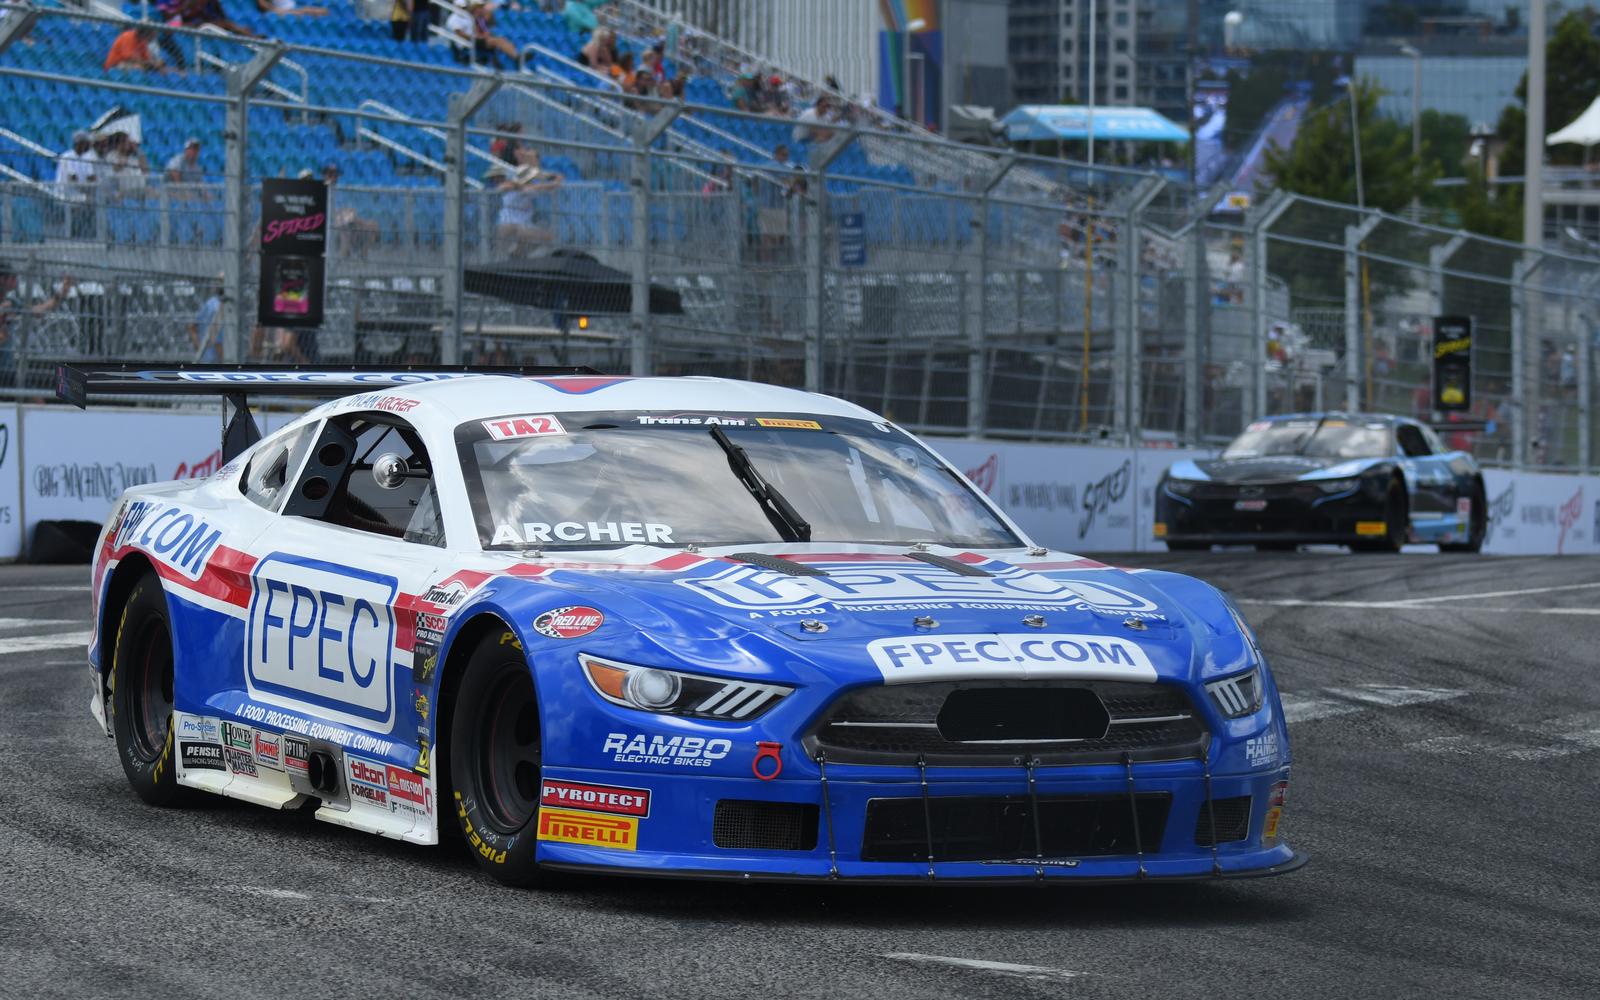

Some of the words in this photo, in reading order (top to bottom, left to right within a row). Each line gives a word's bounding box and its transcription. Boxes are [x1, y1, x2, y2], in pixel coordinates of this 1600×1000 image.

[491, 417, 558, 437] TA2
[637, 416, 702, 425] Trans
[704, 416, 746, 426] Am
[490, 521, 676, 546] ARCHER
[422, 584, 449, 605] Trans
[447, 589, 466, 606] Am
[552, 615, 577, 626] RED
[574, 615, 601, 626] LINE
[749, 612, 764, 621] A
[772, 607, 827, 619] FOOD
[832, 602, 953, 613] PROCESSING
[960, 602, 1068, 612] EQUIPMENT
[261, 578, 379, 689] FPEC
[416, 629, 428, 640] PRO
[425, 615, 447, 632] SCCA
[882, 640, 1138, 668] FPEC.COM
[234, 703, 245, 717] A
[242, 705, 266, 721] FOOD
[264, 710, 311, 735] PROCESSING
[308, 725, 354, 747] EQUIPMENT
[352, 736, 393, 757] COMPANY
[186, 745, 221, 759] PENSKE
[602, 733, 733, 760] RAMBO
[613, 754, 670, 765] ELECTRIC
[673, 756, 713, 767] BIKES
[350, 760, 386, 786] tilton
[399, 777, 424, 797] MISSION
[542, 786, 646, 808] PYROTECT
[453, 790, 508, 864] PIRELLI
[540, 812, 631, 845] PIRELLI
